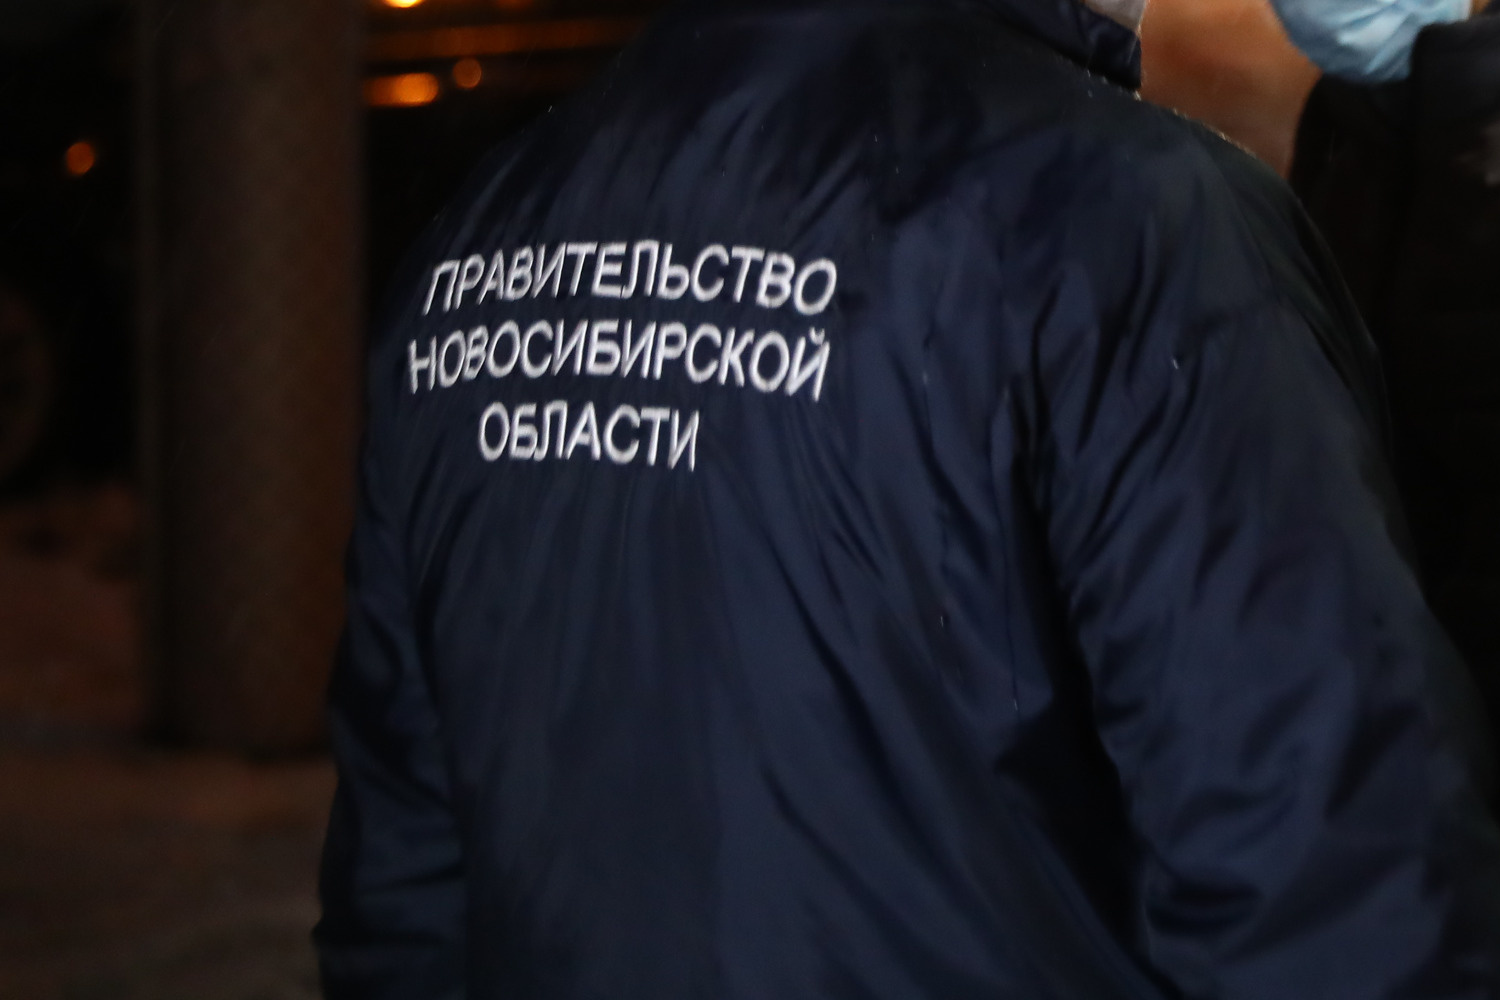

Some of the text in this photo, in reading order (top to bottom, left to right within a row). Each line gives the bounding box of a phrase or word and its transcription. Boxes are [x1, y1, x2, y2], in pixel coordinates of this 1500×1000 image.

[422, 239, 838, 317] ПРАВИТЕЛЬСТВО
[407, 318, 831, 402] НОВОСИБИРСКОЙ
[478, 401, 700, 472] ОБЛАСТИ
